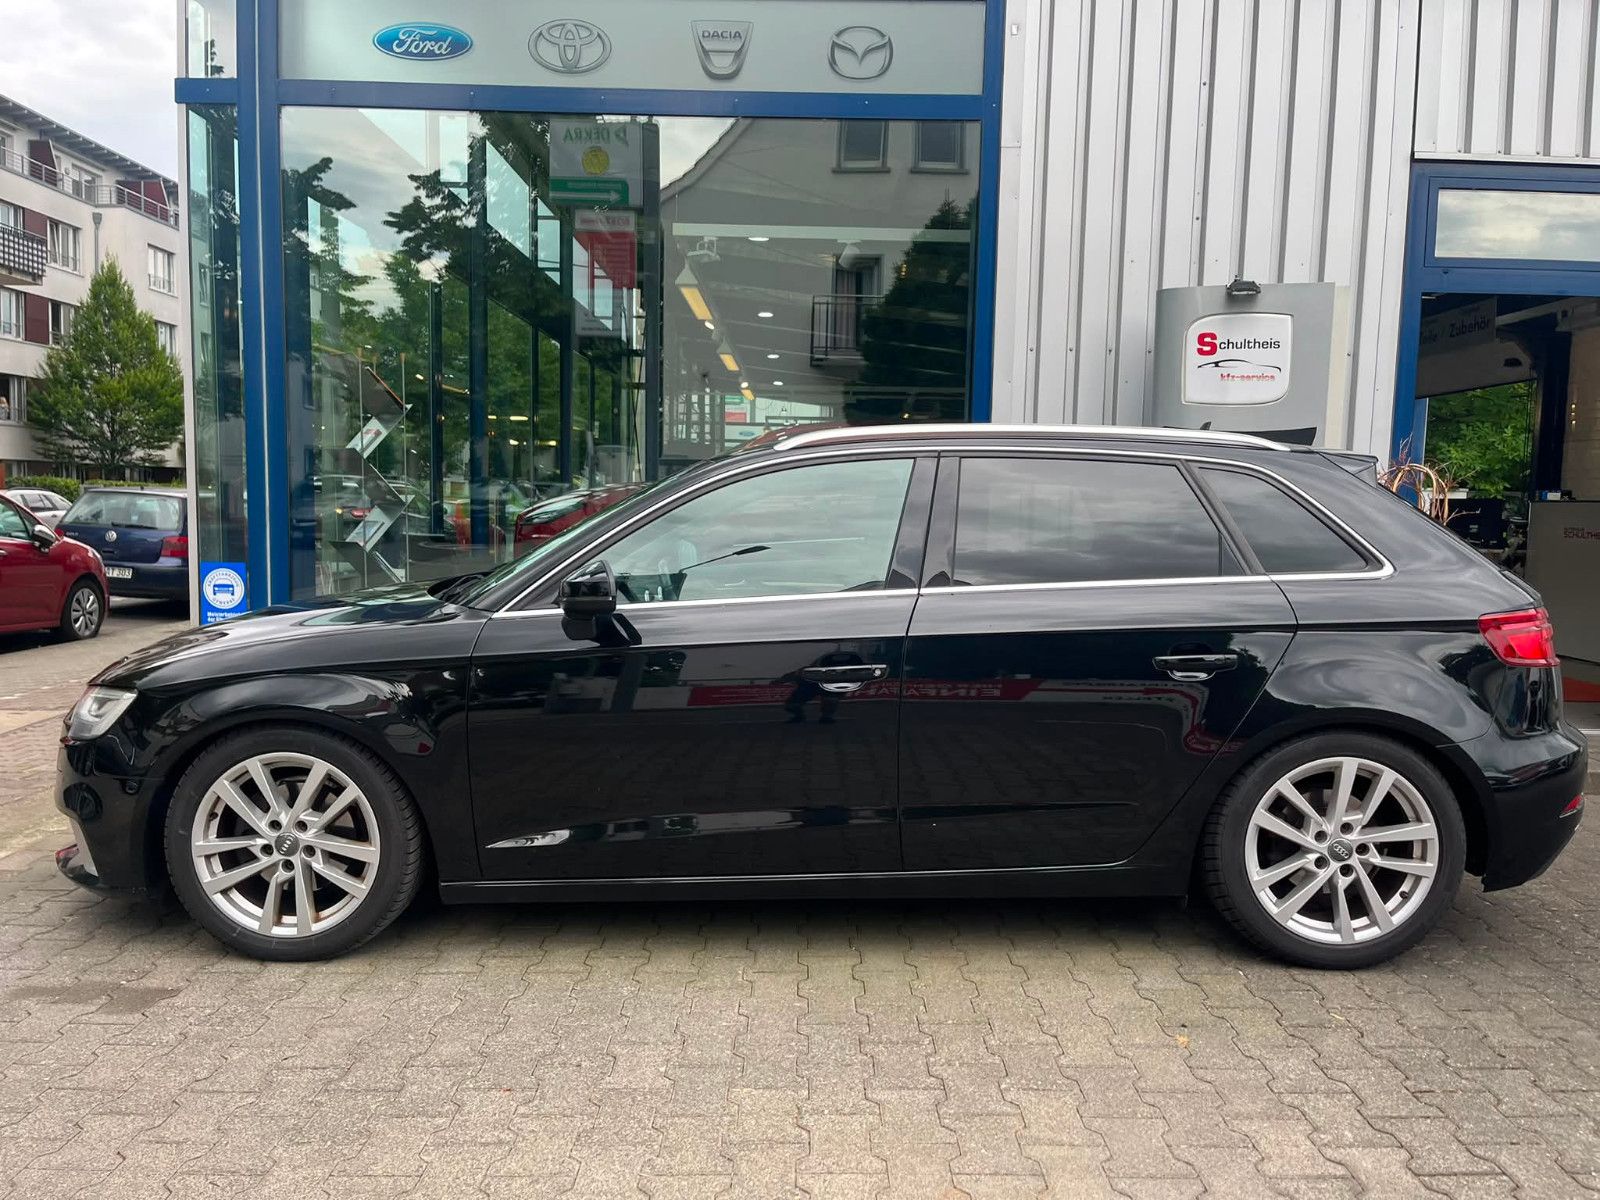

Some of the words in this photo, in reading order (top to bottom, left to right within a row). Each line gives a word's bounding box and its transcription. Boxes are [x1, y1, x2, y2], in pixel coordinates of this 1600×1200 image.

[392, 26, 452, 55] Ford
[701, 29, 743, 41] DACIA
[1196, 332, 1281, 356] Schultheis
[1220, 373, 1276, 382] kfz-service
[116, 569, 131, 579] 303
